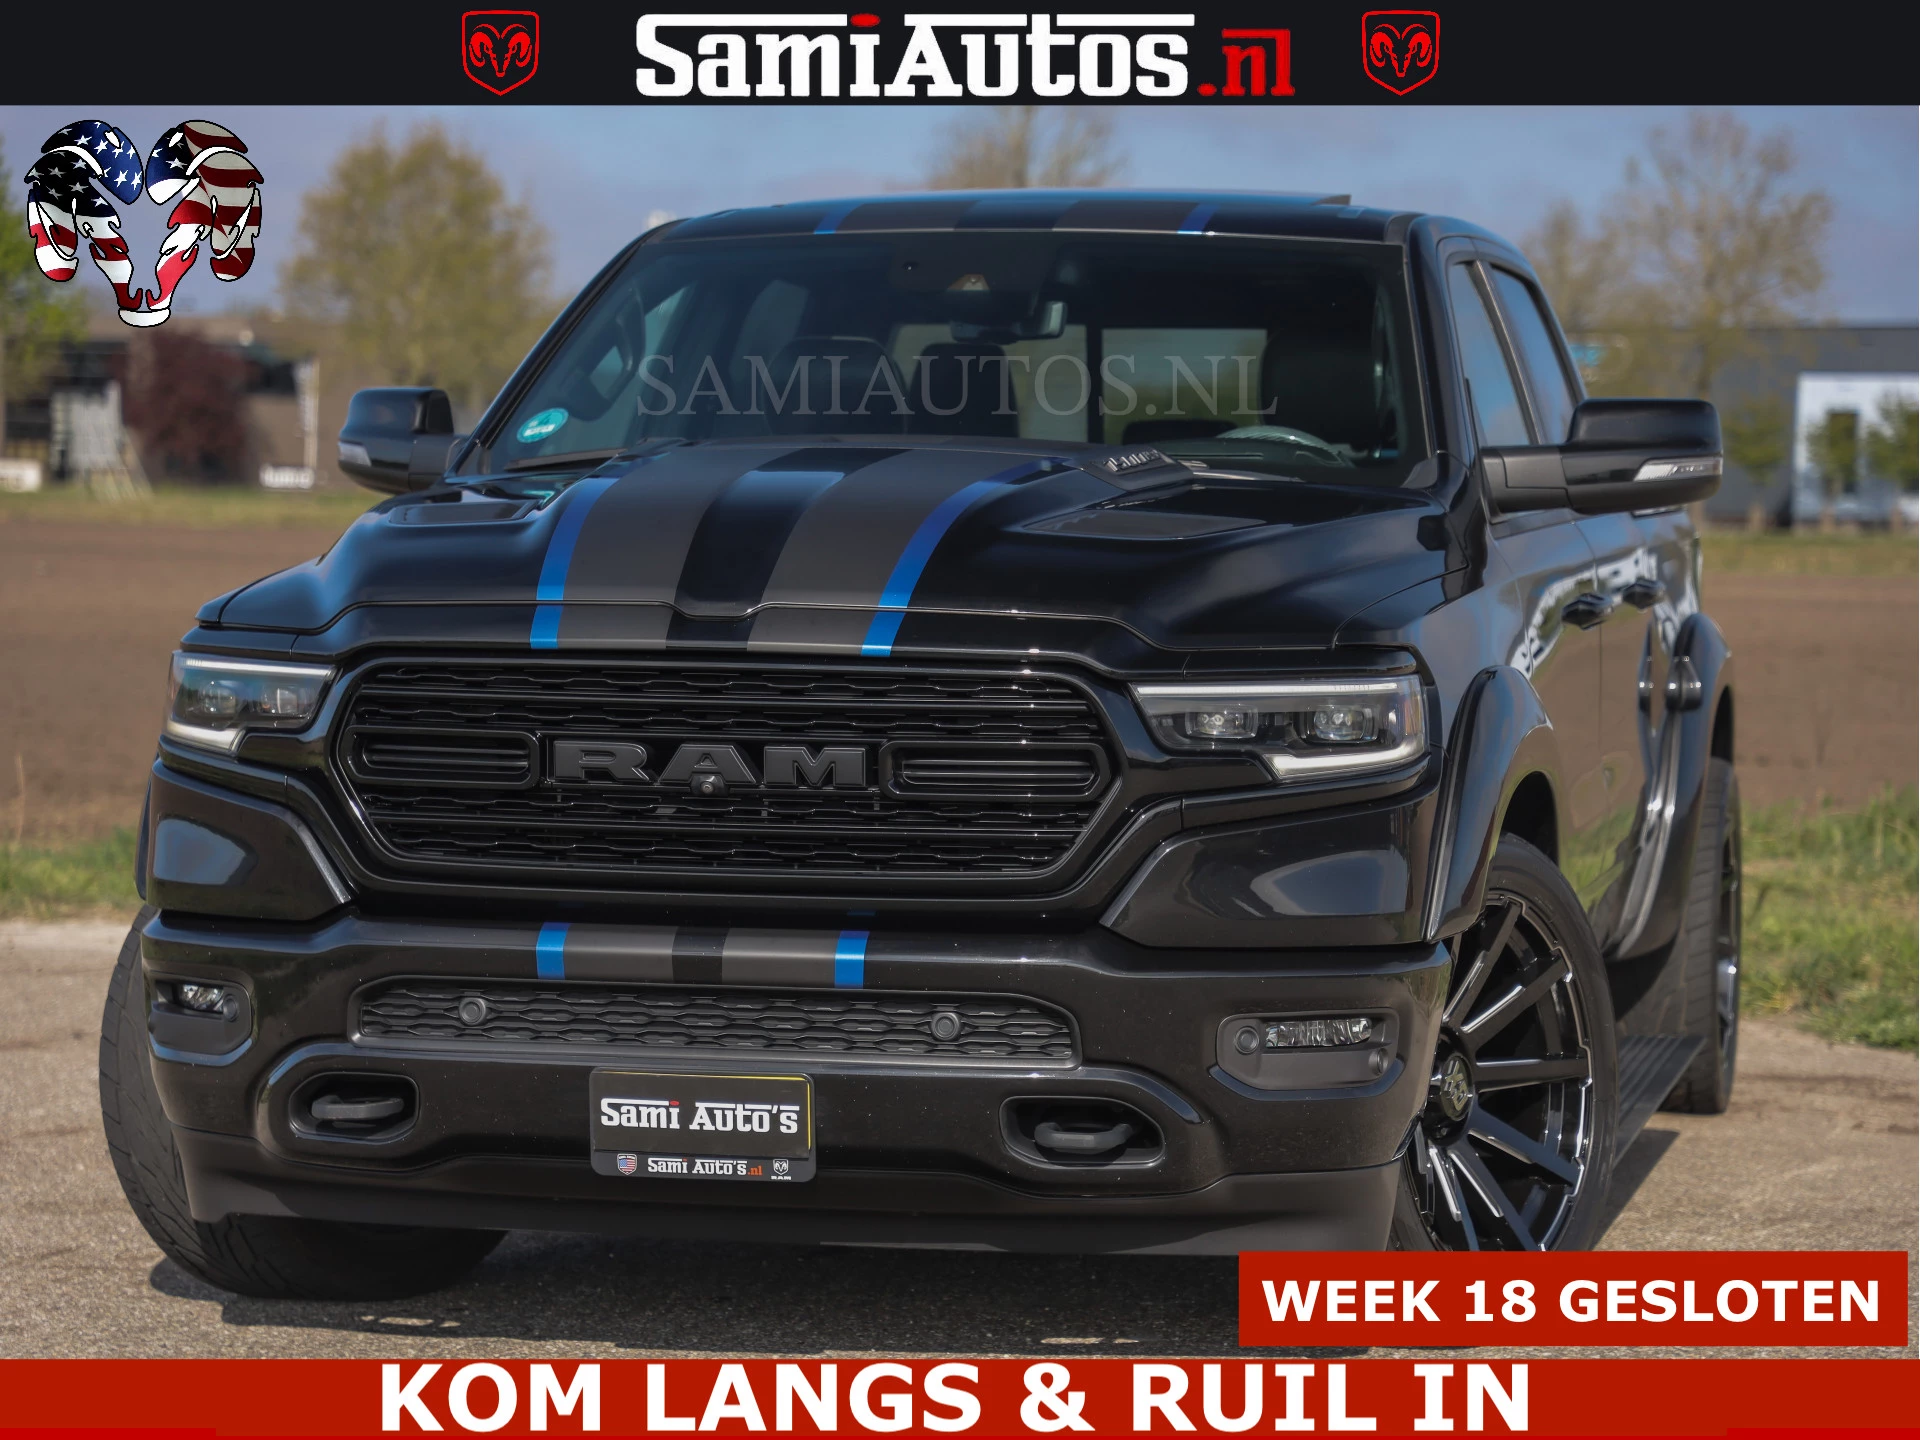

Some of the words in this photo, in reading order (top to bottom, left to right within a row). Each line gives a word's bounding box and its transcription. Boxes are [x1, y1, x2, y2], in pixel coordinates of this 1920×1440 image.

[552, 740, 866, 788] RAM
[600, 1097, 680, 1129] Sami
[689, 1102, 800, 1134] Auto's
[647, 1157, 688, 1174] Sami
